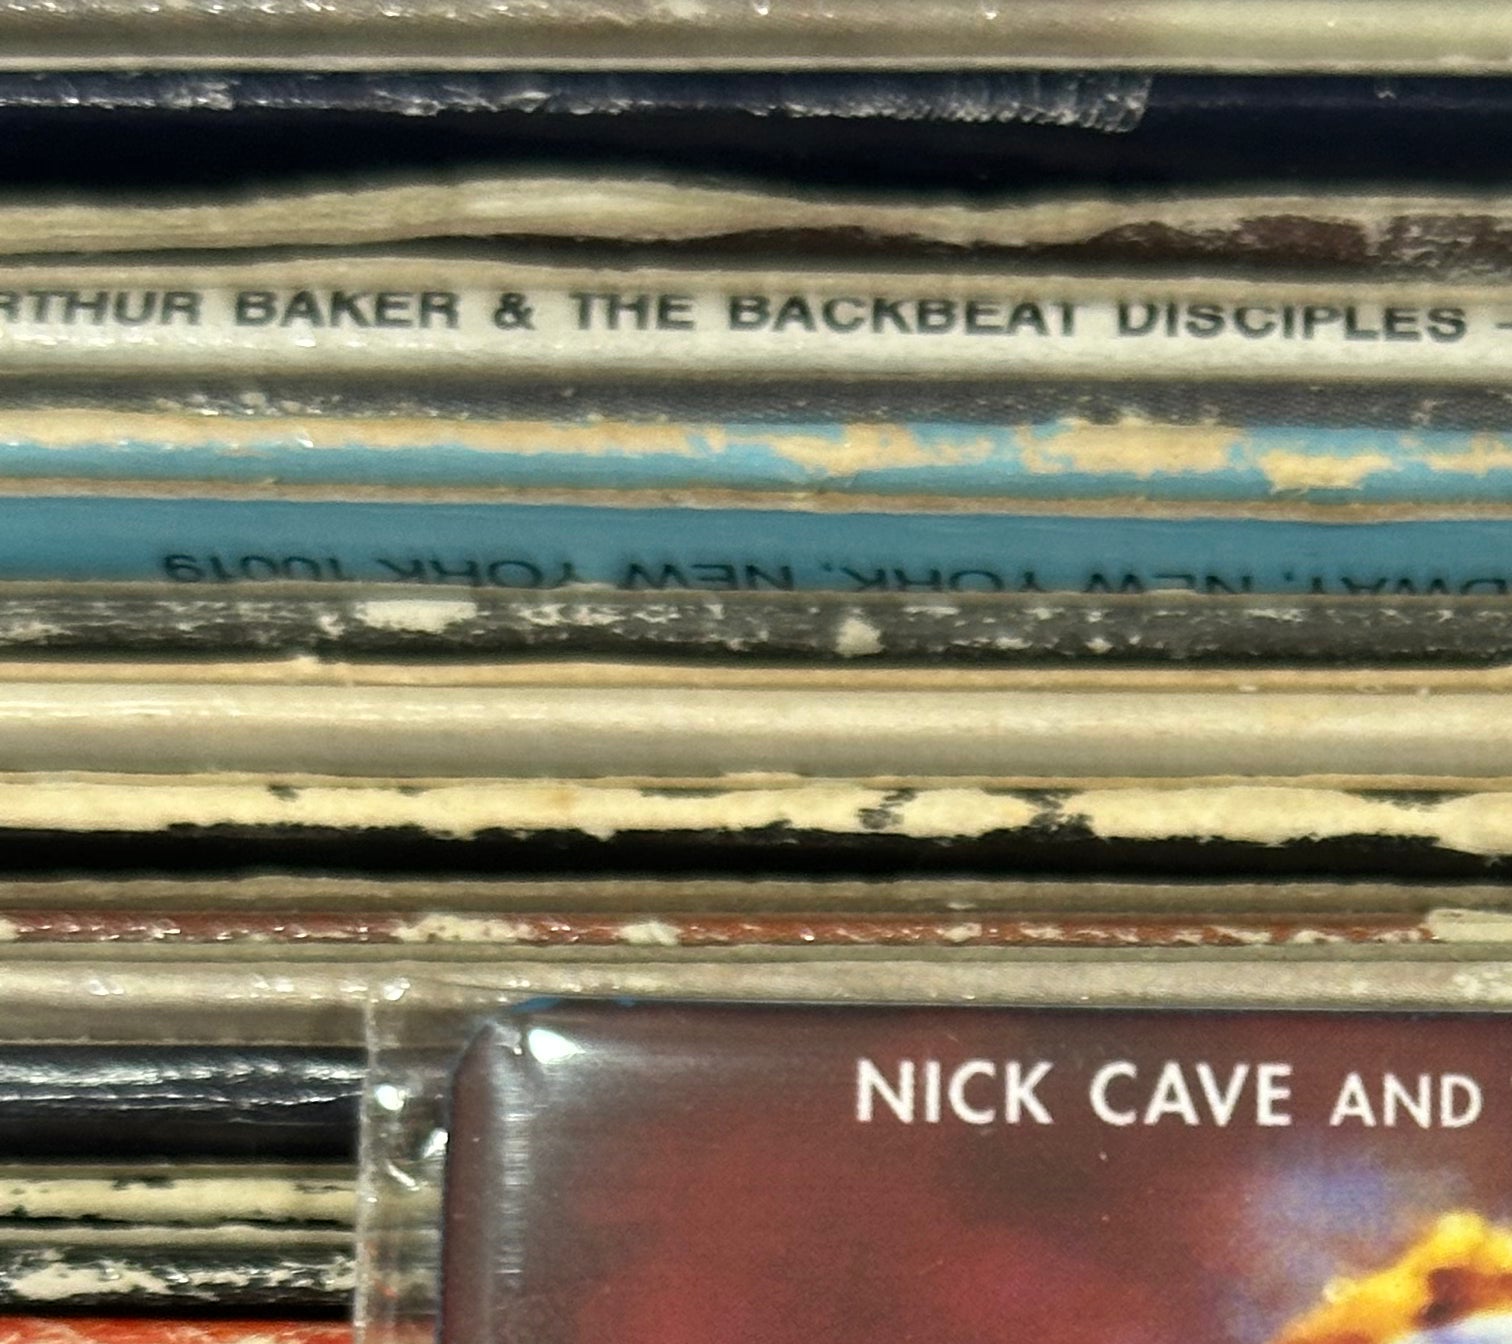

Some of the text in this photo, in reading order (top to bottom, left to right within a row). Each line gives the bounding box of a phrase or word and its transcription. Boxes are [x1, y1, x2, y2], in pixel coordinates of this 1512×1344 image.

[234, 290, 460, 329] BAKER
[492, 292, 536, 330] &
[570, 292, 696, 331] THE
[727, 294, 1078, 337] BACKBEAT
[1115, 301, 1468, 342] DISCIPLES
[855, 1058, 1054, 1126] NICK
[1089, 1061, 1293, 1128] CAVE
[1329, 1072, 1484, 1129] AND
